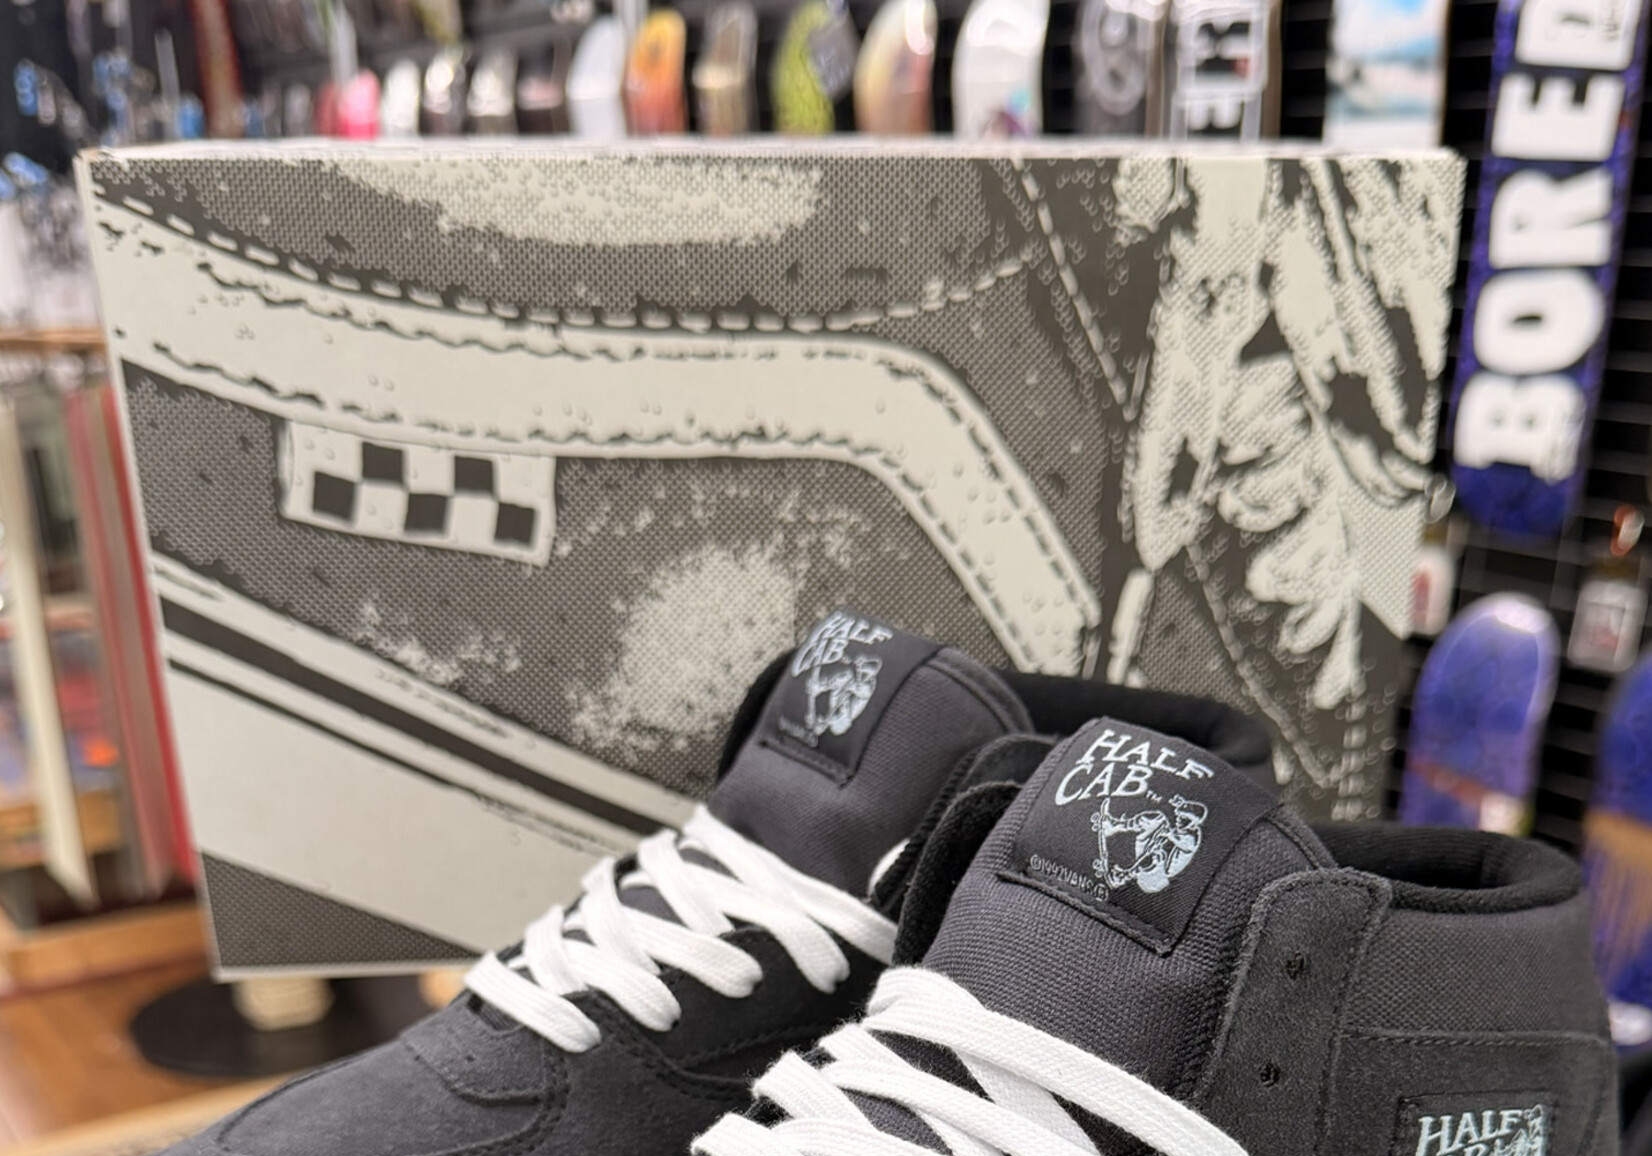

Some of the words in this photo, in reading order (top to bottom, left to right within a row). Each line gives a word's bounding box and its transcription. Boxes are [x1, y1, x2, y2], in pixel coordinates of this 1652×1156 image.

[811, 611, 892, 645] HALF
[792, 638, 849, 677] CAB
[1075, 729, 1214, 780] HALF
